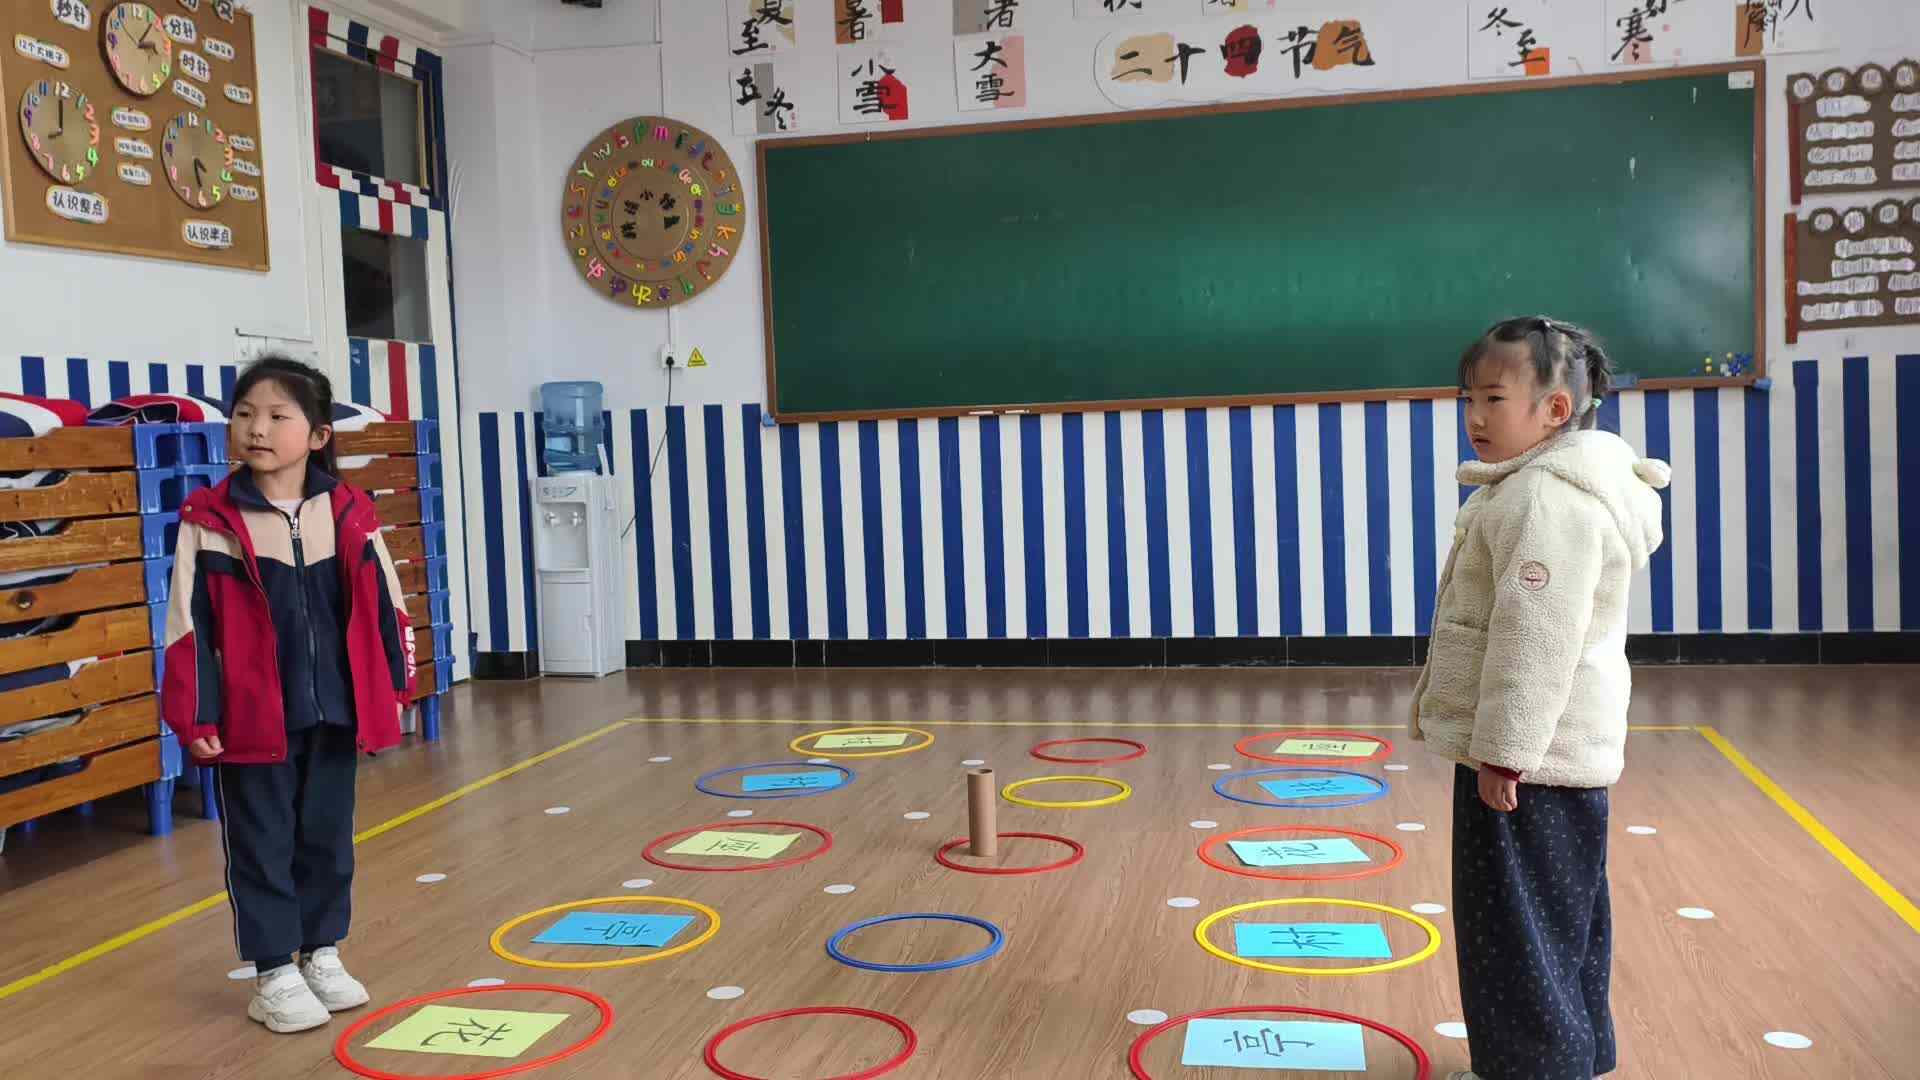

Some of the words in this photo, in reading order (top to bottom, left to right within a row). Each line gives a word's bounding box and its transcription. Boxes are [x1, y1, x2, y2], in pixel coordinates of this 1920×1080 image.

[169, 17, 194, 39] 分针
[1479, 7, 1546, 67] 冬至
[182, 54, 209, 78] 时针
[1111, 25, 1376, 85] 二十四节气
[970, 40, 1015, 102] 大雪
[736, 68, 794, 130] 立冬
[850, 58, 896, 114] 小雪
[52, 191, 104, 217] 认识整点
[186, 226, 231, 243] 认识半点
[1261, 841, 1327, 860] 花
[583, 920, 652, 941] 亭
[1268, 926, 1345, 950] 村
[419, 1017, 514, 1048] 花
[1222, 1026, 1316, 1058] 亭
